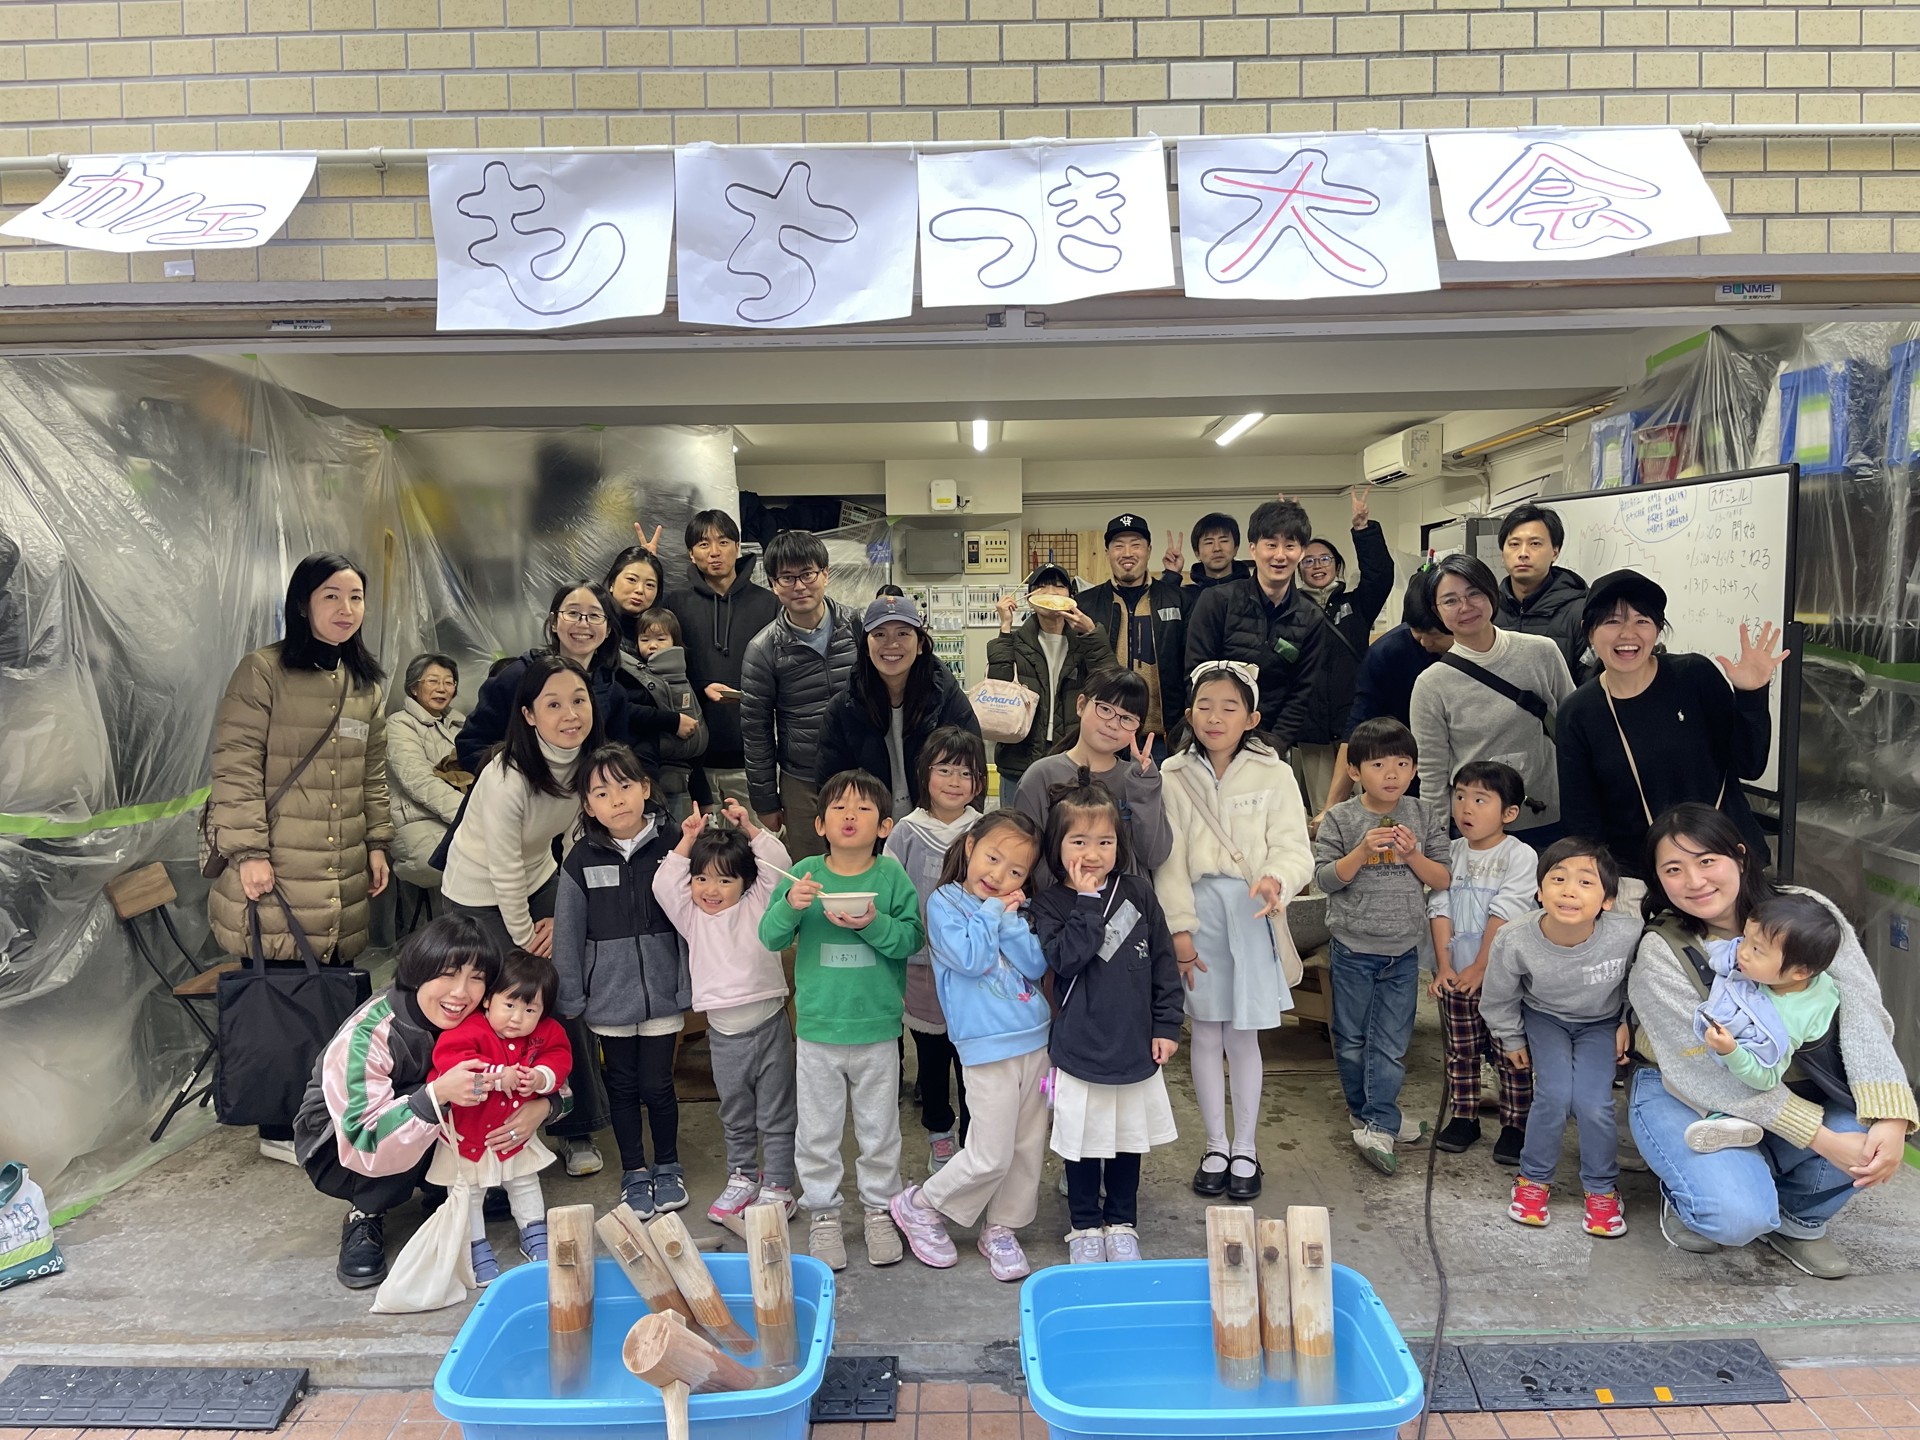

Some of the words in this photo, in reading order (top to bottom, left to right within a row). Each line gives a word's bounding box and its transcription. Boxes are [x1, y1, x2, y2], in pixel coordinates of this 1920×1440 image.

[42, 161, 266, 245] カノエ
[1722, 283, 1775, 294] BUNMEI
[1731, 519, 1756, 542] 開始
[1740, 548, 1771, 570] こねる
[1742, 582, 1760, 604] つく
[975, 689, 1021, 707] Leonard's
